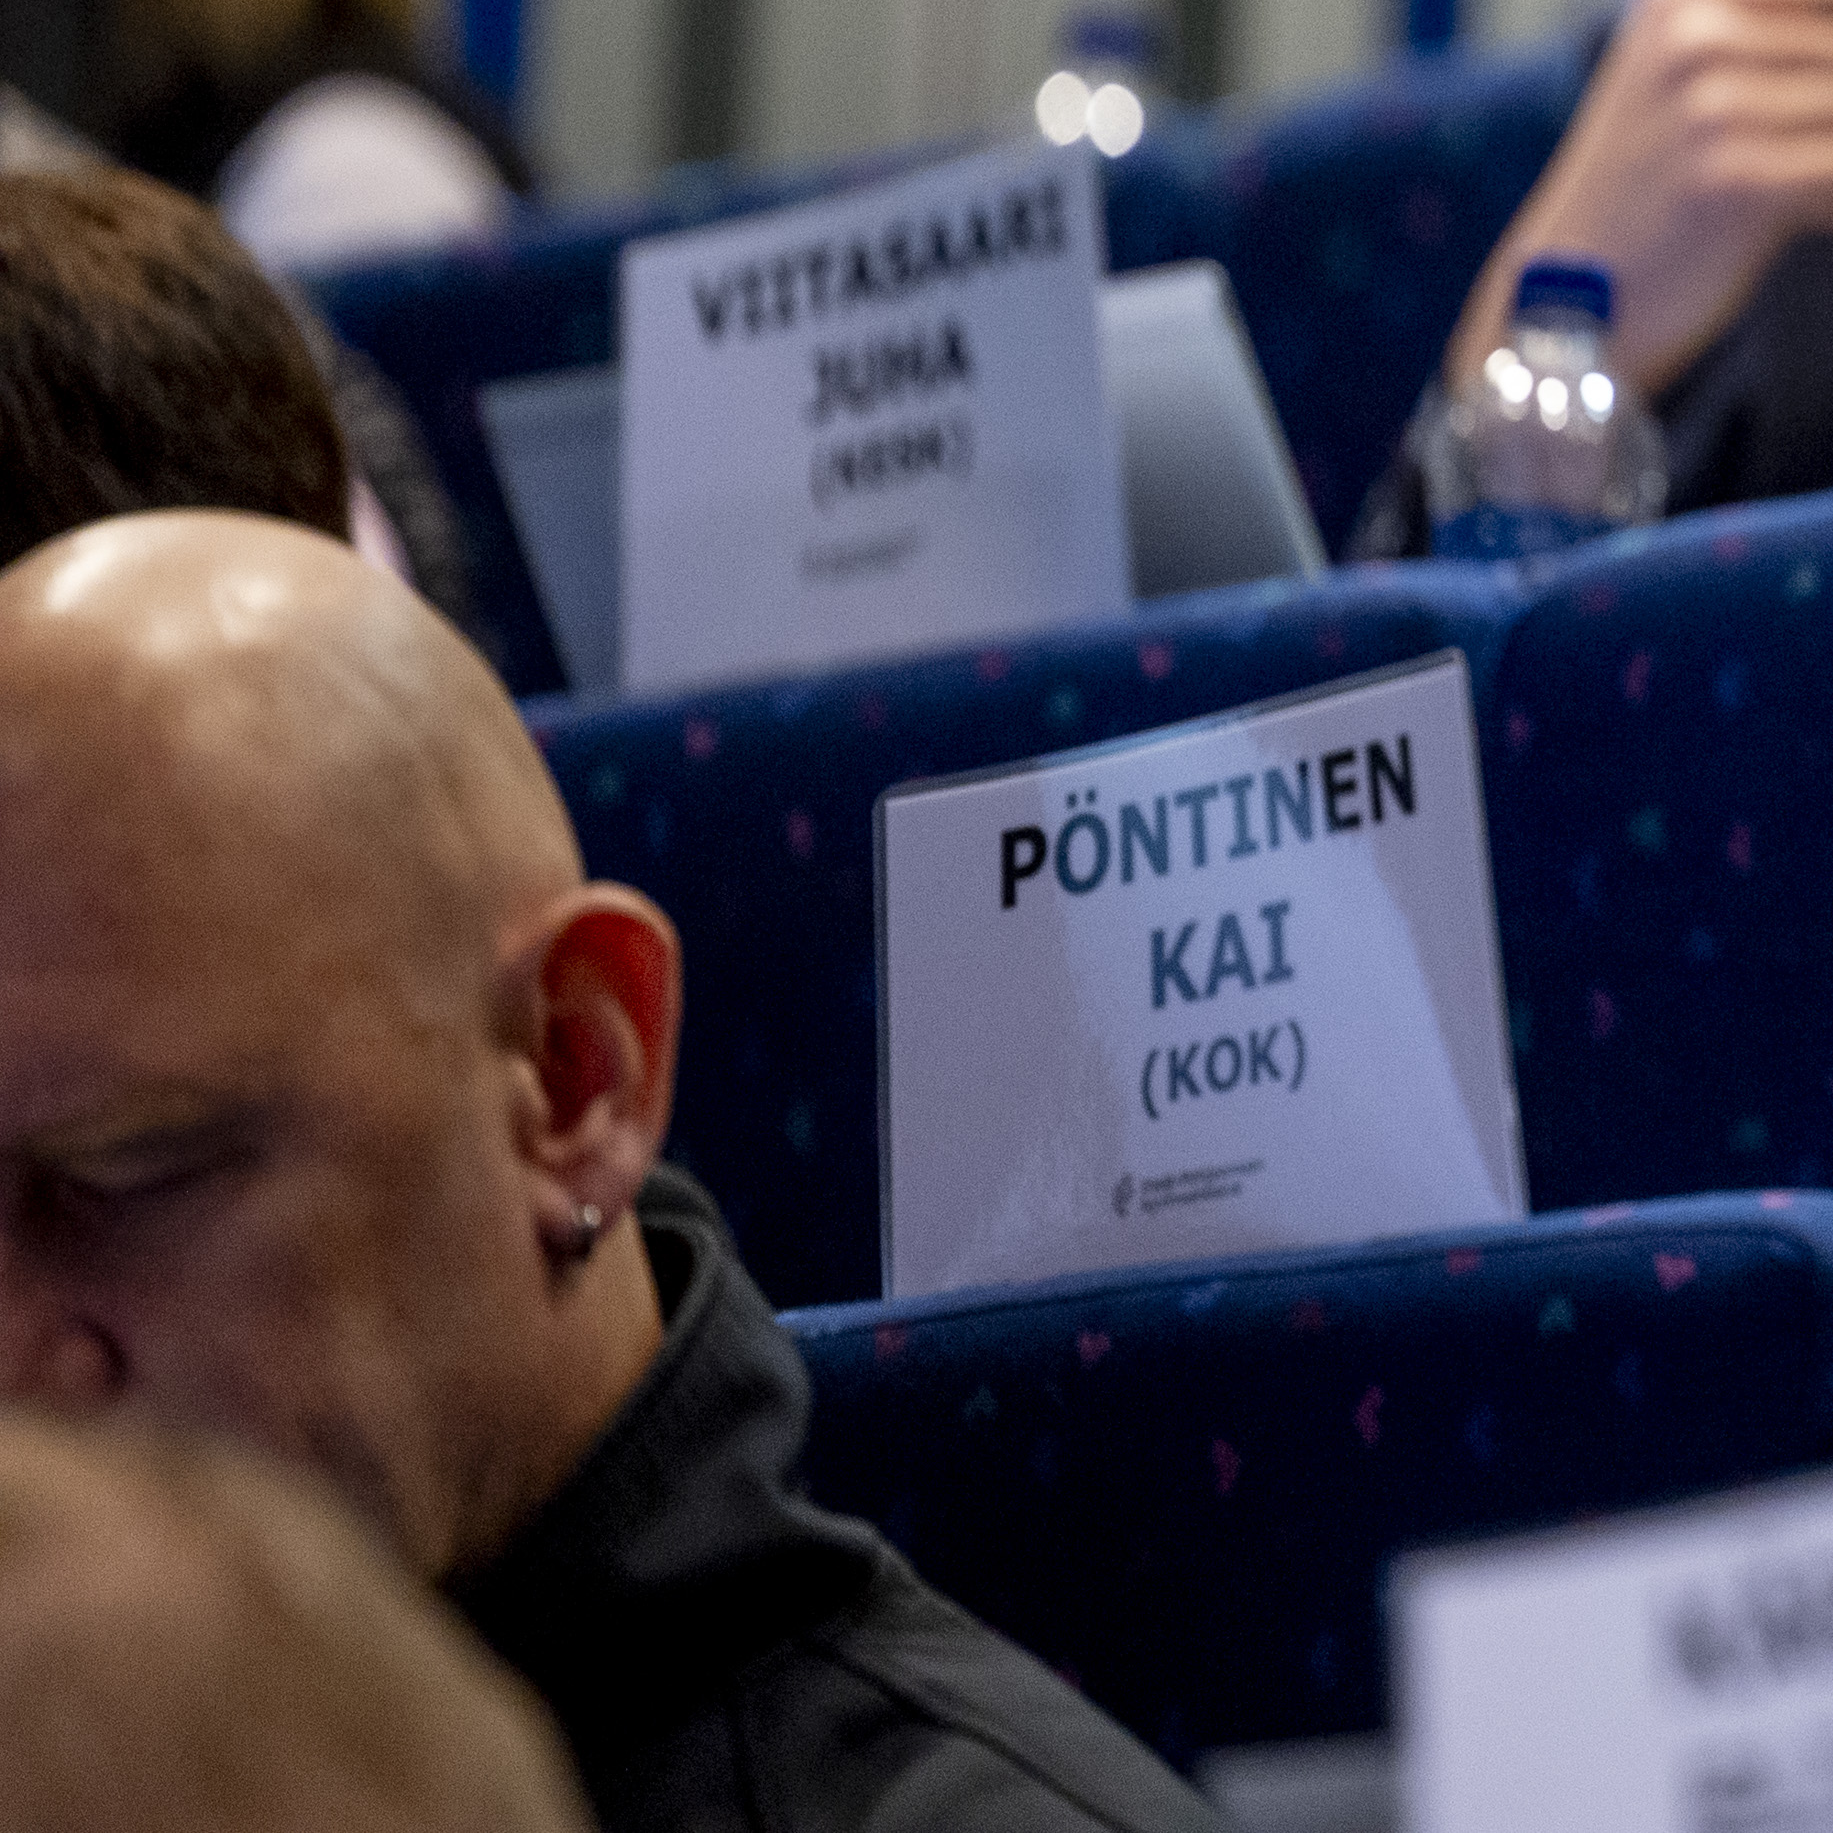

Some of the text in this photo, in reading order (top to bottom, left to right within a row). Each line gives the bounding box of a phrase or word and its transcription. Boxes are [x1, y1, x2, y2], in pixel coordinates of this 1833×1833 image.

[693, 176, 1069, 347] VIITASAARI
[808, 314, 974, 426] JUHA
[1000, 734, 1418, 910] PÖNTINEN
[1150, 900, 1295, 1010] KAI
[1140, 1020, 1309, 1121] (KOK)
